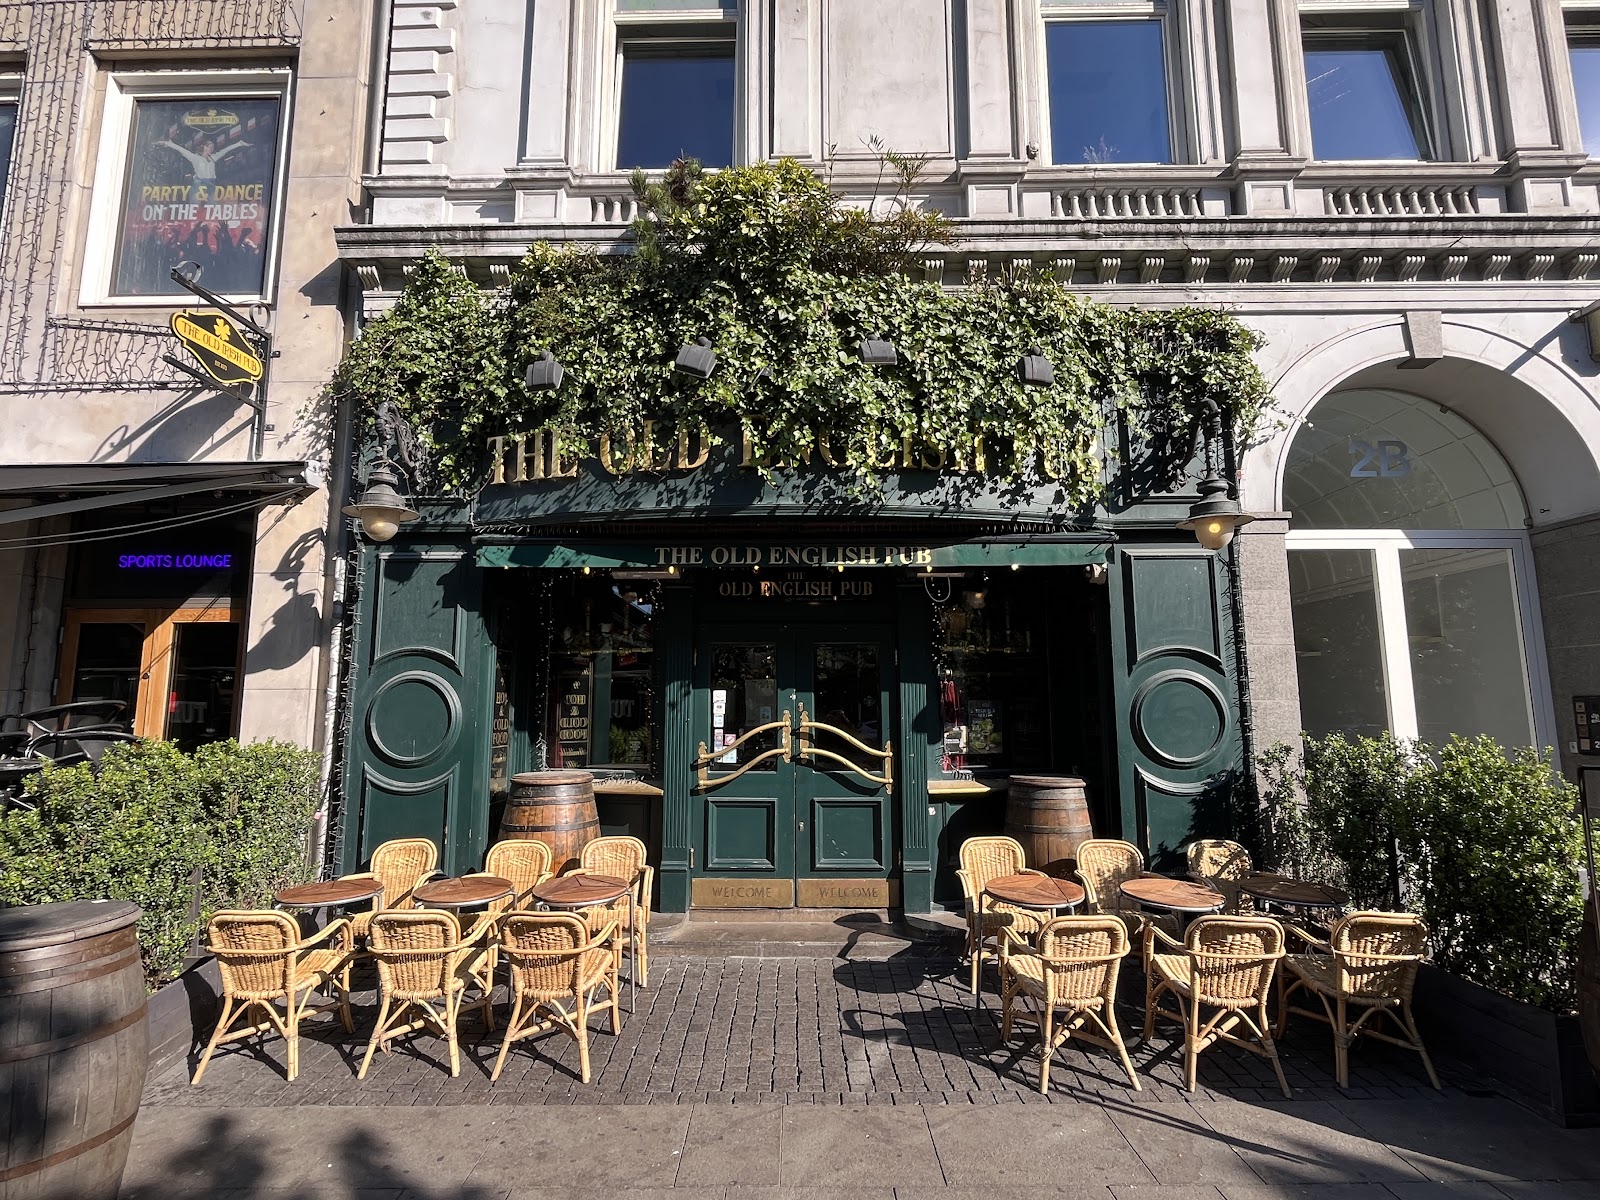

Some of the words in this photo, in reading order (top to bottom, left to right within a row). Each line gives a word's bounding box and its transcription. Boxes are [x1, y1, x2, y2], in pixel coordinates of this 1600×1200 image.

[142, 185, 191, 201] PARTY
[195, 185, 208, 201] &
[214, 184, 264, 201] DANCE
[143, 204, 164, 221] ON
[170, 203, 199, 220] THE
[204, 203, 258, 220] TABLES
[182, 320, 201, 342] THE
[203, 333, 220, 351] OLD
[222, 342, 242, 363] IRISH
[243, 354, 257, 372] PUB
[486, 429, 579, 485] THE
[599, 418, 712, 475] OLD
[1349, 441, 1409, 477] 2B
[119, 555, 172, 568] SPORTS
[176, 554, 232, 567] LOUNGE
[655, 546, 704, 565] THE
[711, 546, 762, 565] OLD
[768, 546, 880, 565] ENGLISH
[885, 546, 932, 565] PUB
[786, 571, 806, 580] THE
[719, 581, 754, 597] OLD
[759, 580, 833, 597] ENGLISH
[840, 580, 873, 597] PUB
[712, 887, 772, 898] WELCOME
[819, 887, 878, 898] WELCOME
